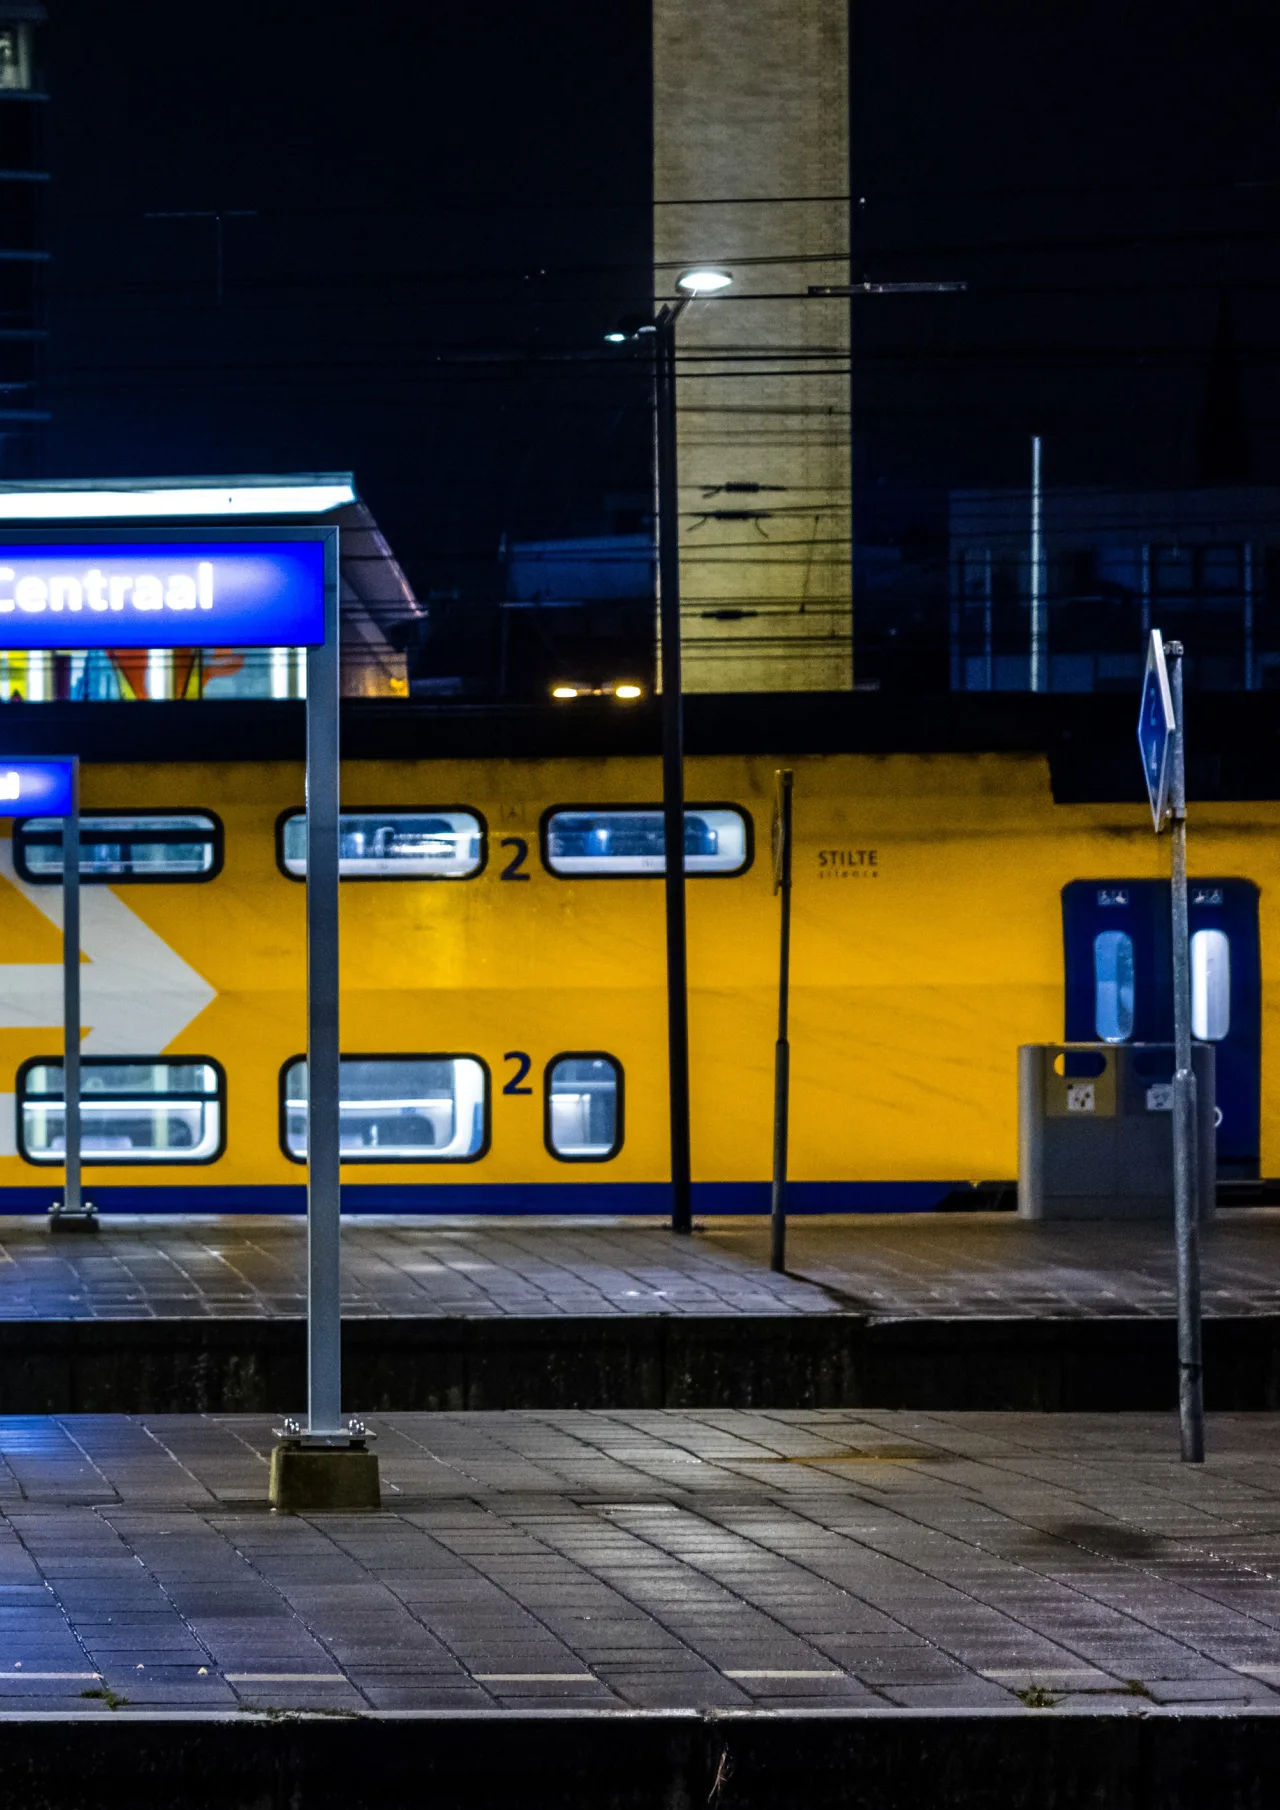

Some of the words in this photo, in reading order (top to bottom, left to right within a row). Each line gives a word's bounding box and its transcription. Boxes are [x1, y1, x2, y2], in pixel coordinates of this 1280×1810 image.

[500, 837, 531, 881] 2
[817, 850, 878, 867] STILTE
[503, 1051, 533, 1095] 2
